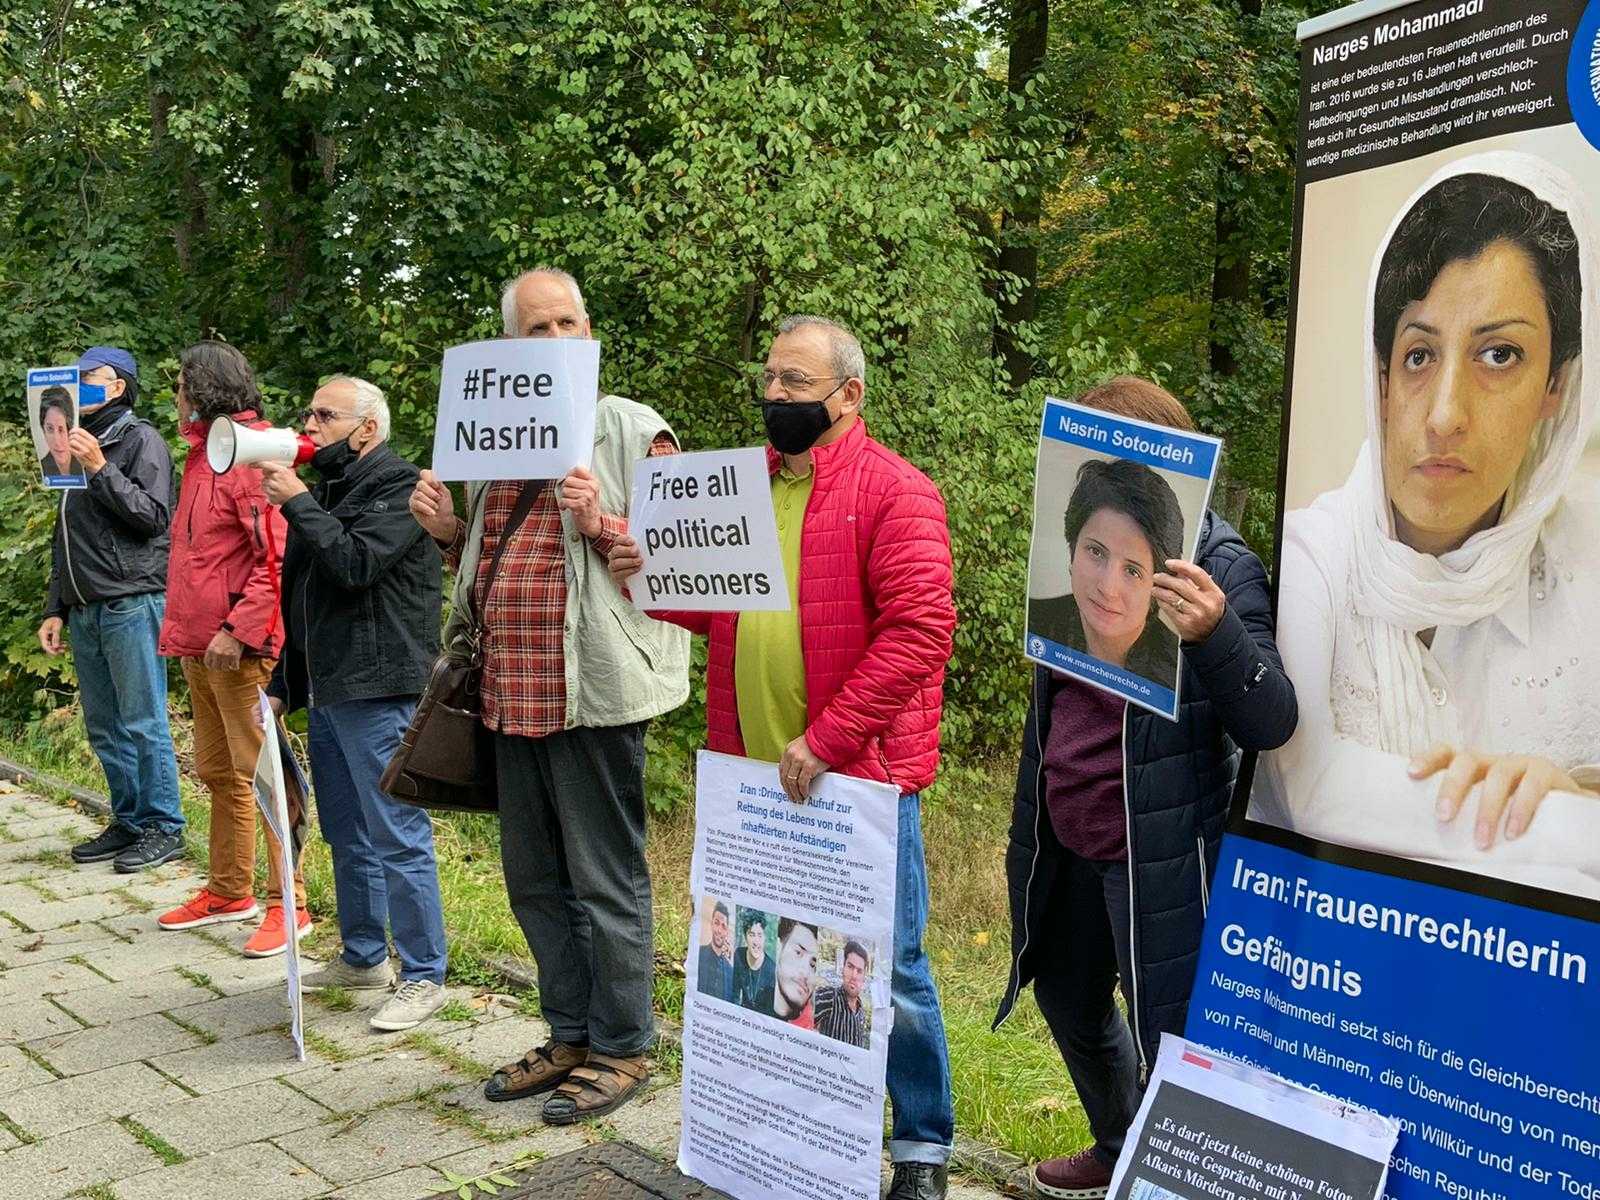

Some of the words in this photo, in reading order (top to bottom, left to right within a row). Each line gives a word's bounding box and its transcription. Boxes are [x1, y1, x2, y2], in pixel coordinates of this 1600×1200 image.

[1310, 100, 1327, 111] Iran.
[1330, 90, 1350, 106] 2016
[1352, 84, 1379, 99] wurde
[1381, 79, 1395, 91] sie
[1397, 76, 1409, 87] zu
[1412, 70, 1423, 82] 16
[1425, 61, 1455, 79] Jahren
[1458, 52, 1478, 68] Haft
[1480, 38, 1527, 60] verurteilt.
[1532, 28, 1568, 46] Durch
[1311, 82, 1320, 93] ist
[1322, 78, 1339, 90] eine
[1341, 73, 1355, 84] der
[1357, 52, 1424, 79] bedeutendsten
[1427, 20, 1523, 58] Frauenrechtlerinnen
[1526, 14, 1547, 27] des
[1314, 36, 1368, 66] Narges
[1308, 137, 1325, 149] terte
[1327, 130, 1344, 143] sich
[1346, 128, 1357, 138] ihr
[1359, 100, 1449, 134] Gesundheitszustand
[1451, 85, 1506, 117] dramatisch.
[1511, 79, 1536, 93] Not-
[1309, 104, 1379, 130] Haftbedingungen
[1382, 96, 1399, 110] und
[1402, 75, 1473, 105] Misshandlungen
[1477, 57, 1538, 91] verschlech-
[1307, 152, 1339, 167] wendige
[1342, 137, 1399, 158] medizinische
[1402, 121, 1452, 144] Behandlung
[1454, 112, 1474, 127] wird
[1476, 110, 1489, 122] ihr
[1492, 96, 1555, 118] verweigert.
[464, 368, 553, 400] #Free
[456, 417, 558, 451] Nasrin
[1059, 416, 1107, 442] Nasrin
[1112, 431, 1194, 465] Sotoudeh
[650, 471, 699, 501] Free
[707, 465, 738, 497] all
[646, 516, 750, 556] political
[646, 568, 771, 601] prisoners
[738, 801, 768, 820] Rettung
[770, 808, 784, 820] des
[786, 811, 815, 827] Lebens
[817, 820, 833, 830] von
[836, 821, 853, 835] drei
[740, 783, 756, 795] Iran
[807, 796, 835, 811] Aufruf
[836, 804, 852, 814] zur
[742, 820, 788, 839] inhaftierten
[790, 831, 846, 853] Aufständigen
[1233, 859, 1290, 904] Iran:
[1294, 878, 1586, 984] Frauenrechtlerin
[1221, 924, 1361, 997] Gefängnis
[1212, 971, 1261, 1000] Narges
[1264, 989, 1335, 1029] Mohammedi
[1340, 1020, 1378, 1041] setzt
[1383, 1031, 1412, 1052] sich
[1418, 1040, 1438, 1060] für
[1442, 1050, 1464, 1071] die
[1205, 1009, 1230, 1027] von
[1235, 1016, 1272, 1045] Frauen
[1274, 1037, 1298, 1055] und
[1304, 1043, 1373, 1082] Männern,
[1380, 1069, 1403, 1089] die
[1409, 1075, 1513, 1134] Überwindung
[1520, 1121, 1554, 1143] von
[1142, 1153, 1182, 1179] Afkaris
[1149, 1136, 1172, 1155] und
[1172, 1146, 1200, 1165] nette
[1202, 1156, 1263, 1191] Gespräche
[1265, 1186, 1286, 1200] mit
[1178, 1126, 1204, 1150] darf
[1202, 1136, 1230, 1156] jetzt
[1231, 1146, 1263, 1170] keine
[1264, 1163, 1314, 1191] schönen
[1397, 1116, 1417, 1136] on
[1422, 1123, 1473, 1158] Willkür
[1479, 1150, 1513, 1173] und
[1520, 1162, 1552, 1184] der
